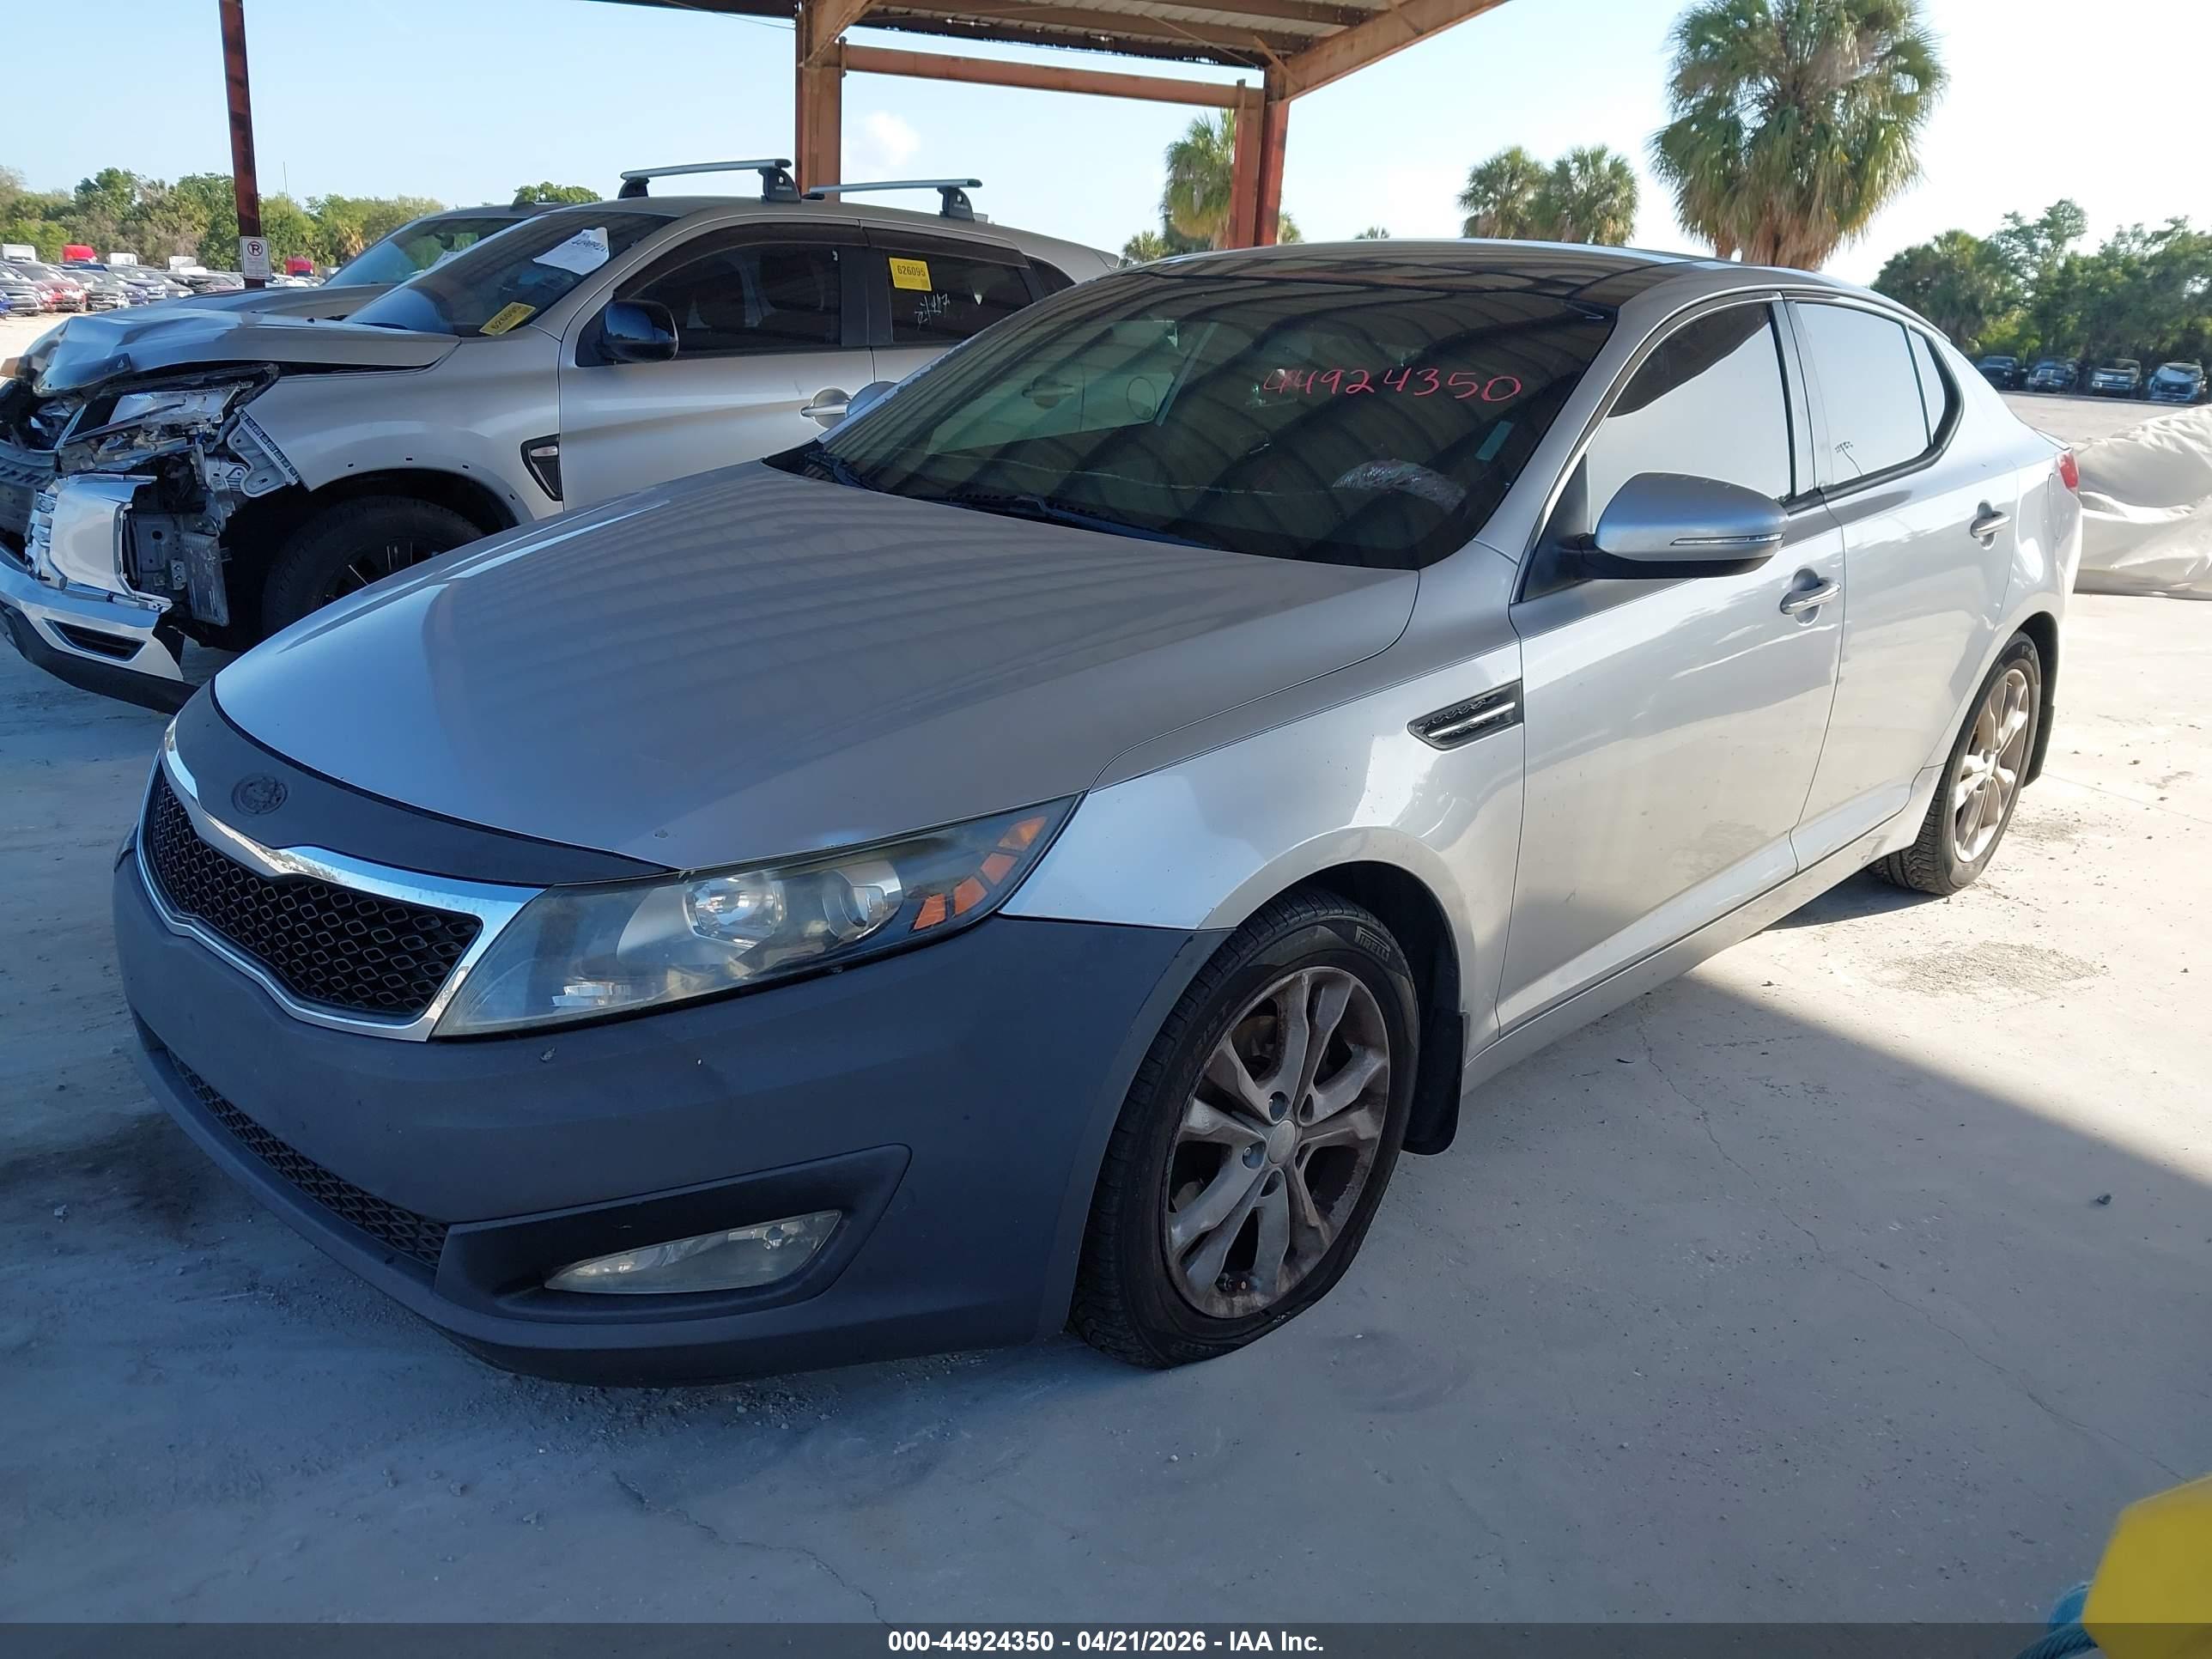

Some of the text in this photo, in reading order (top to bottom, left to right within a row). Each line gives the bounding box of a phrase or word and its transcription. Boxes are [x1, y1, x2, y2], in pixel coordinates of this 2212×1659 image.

[896, 264, 927, 277] 626095
[1262, 367, 1522, 402] 44924350
[1354, 926, 1391, 963] PIRELLI
